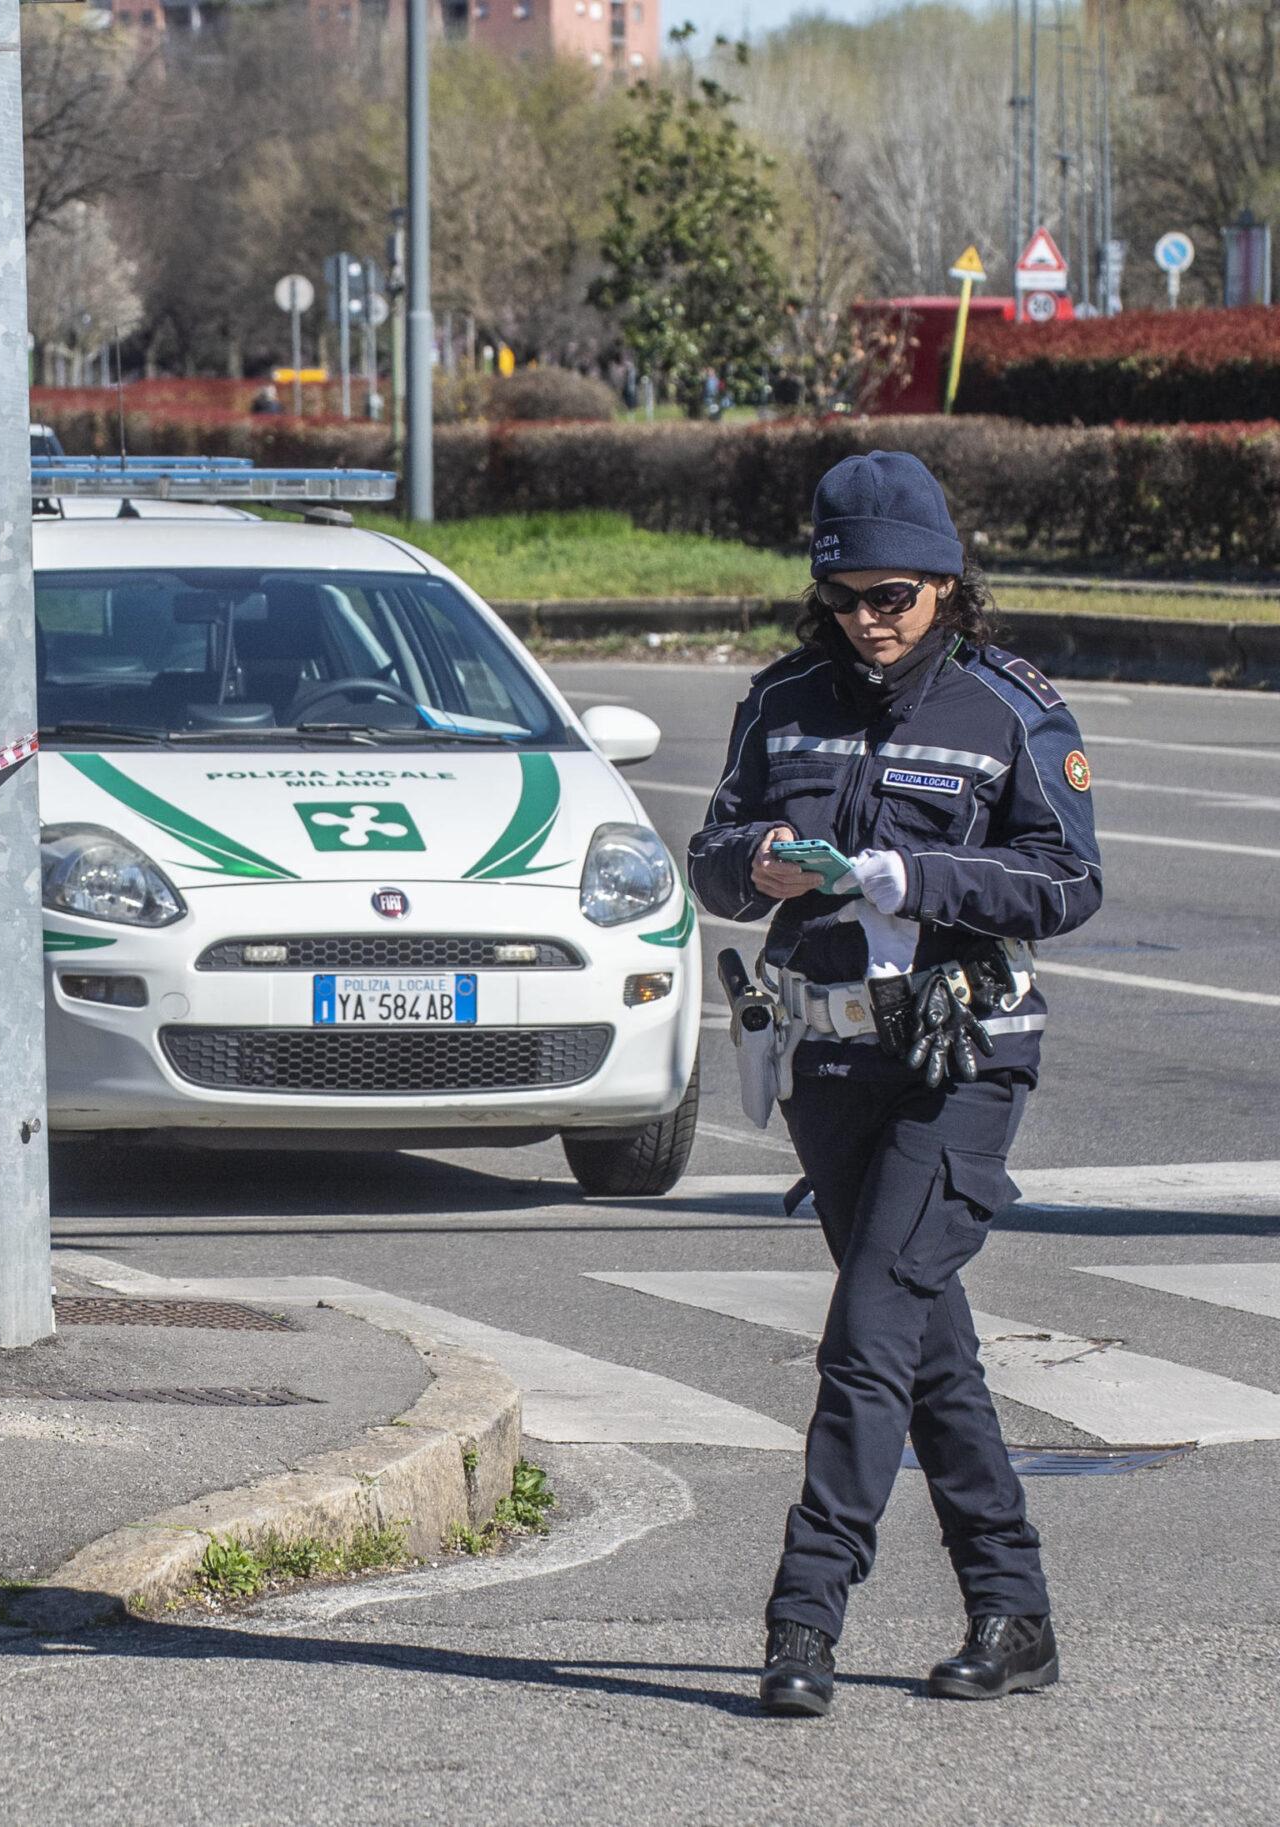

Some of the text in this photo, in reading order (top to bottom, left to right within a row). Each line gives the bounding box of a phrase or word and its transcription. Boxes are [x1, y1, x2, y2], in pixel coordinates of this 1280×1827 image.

[206, 770, 457, 780] POLIZIA LOCALE
[888, 772, 957, 789] POLIZIA LOCALE
[285, 780, 391, 788] MILANO
[380, 894, 402, 911] FIAT
[344, 979, 447, 992] POLIZIA LOCALE
[338, 993, 366, 1021] YA
